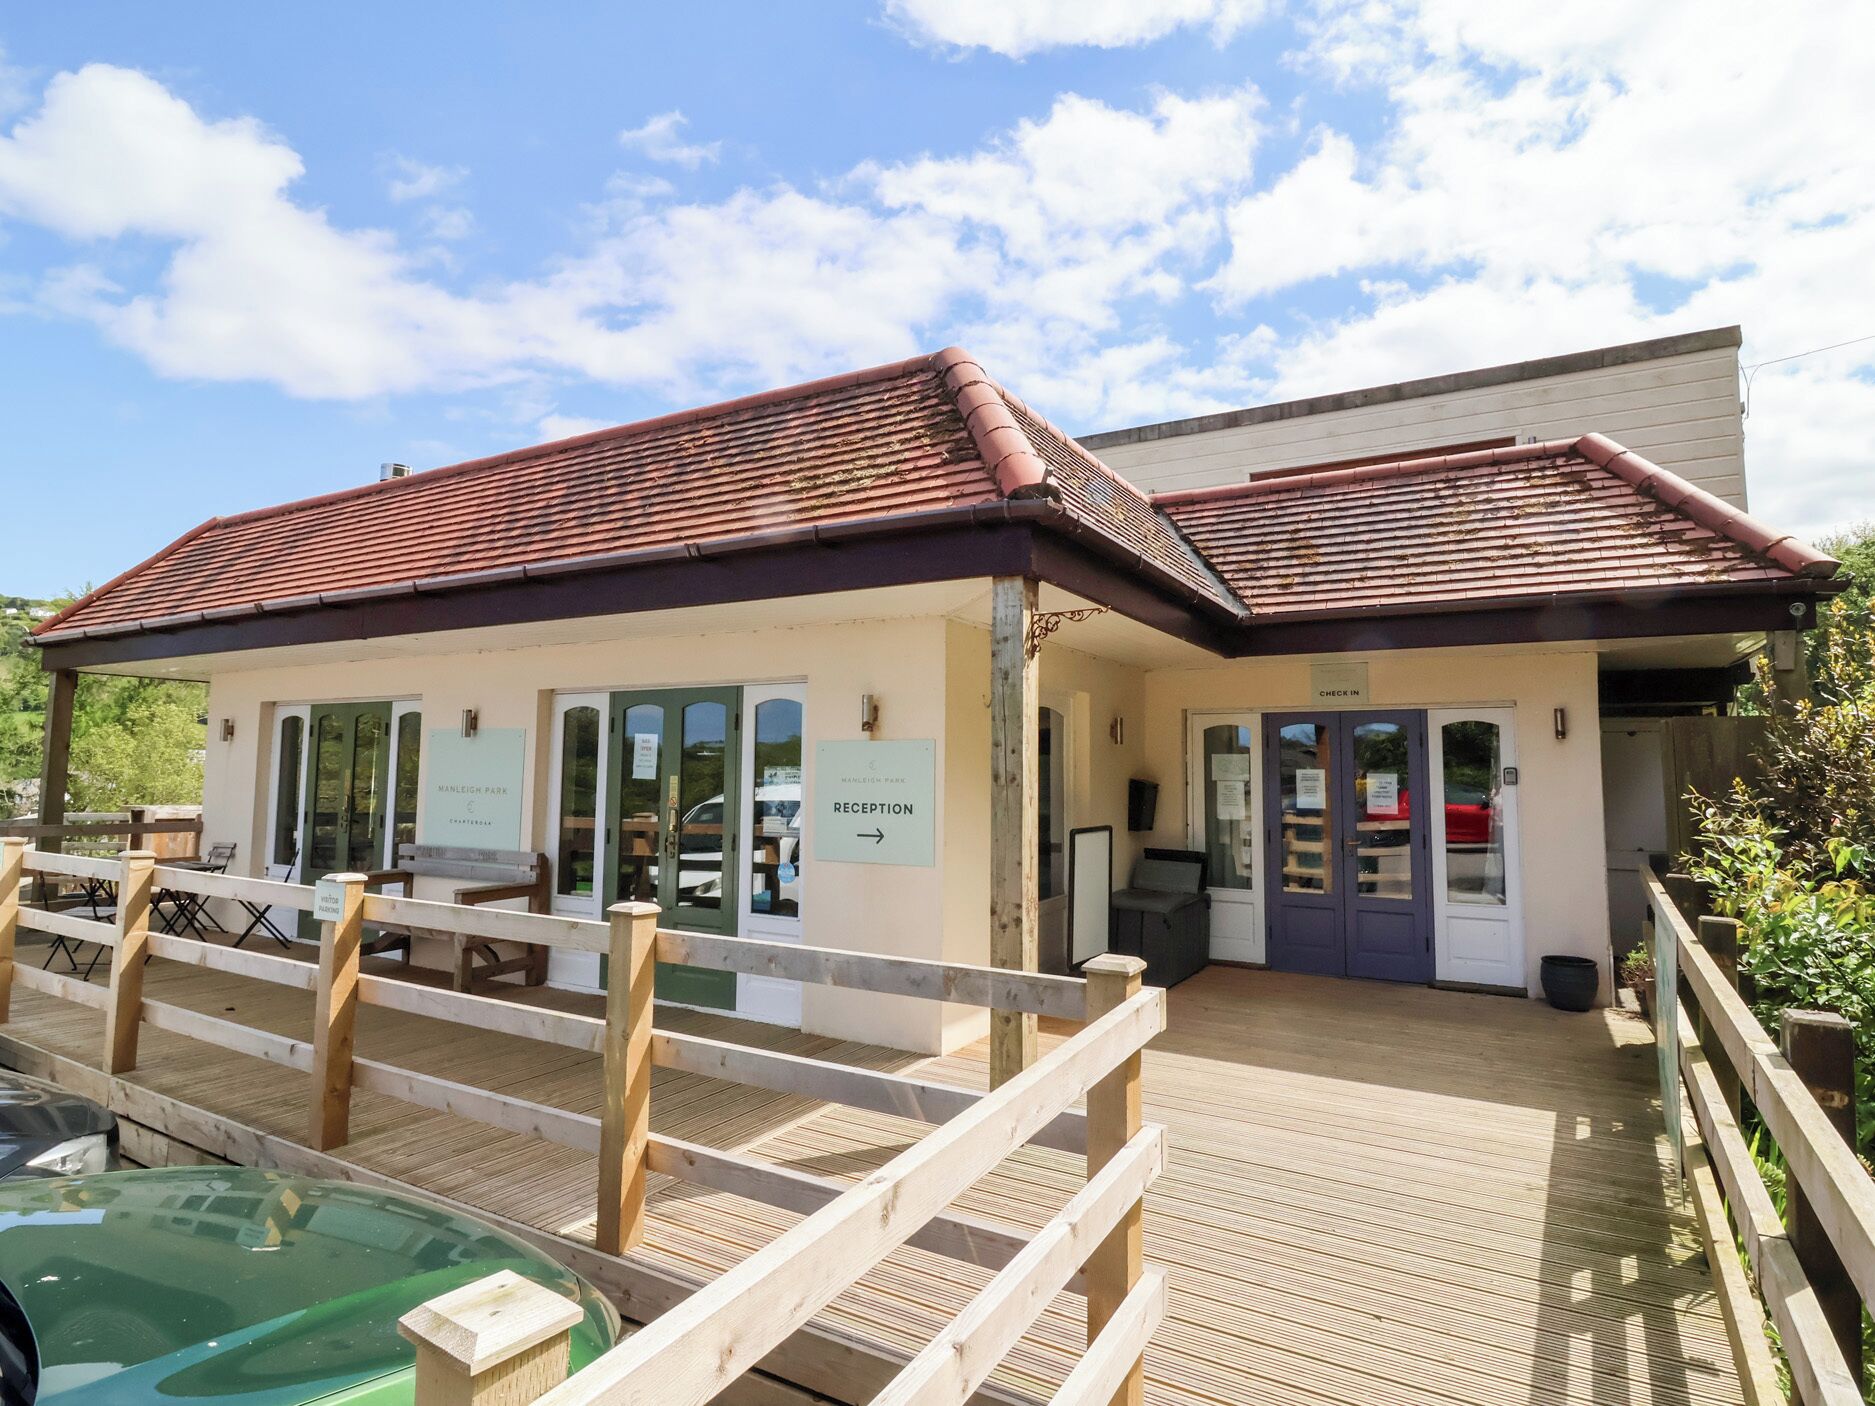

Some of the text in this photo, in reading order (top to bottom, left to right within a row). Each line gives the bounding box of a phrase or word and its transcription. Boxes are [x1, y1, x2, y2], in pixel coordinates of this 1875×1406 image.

[438, 785, 508, 795] MANLEIGH PARK
[833, 802, 913, 815] RECEPTION
[321, 896, 339, 904] VISITOR
[319, 905, 340, 914] PARKING
